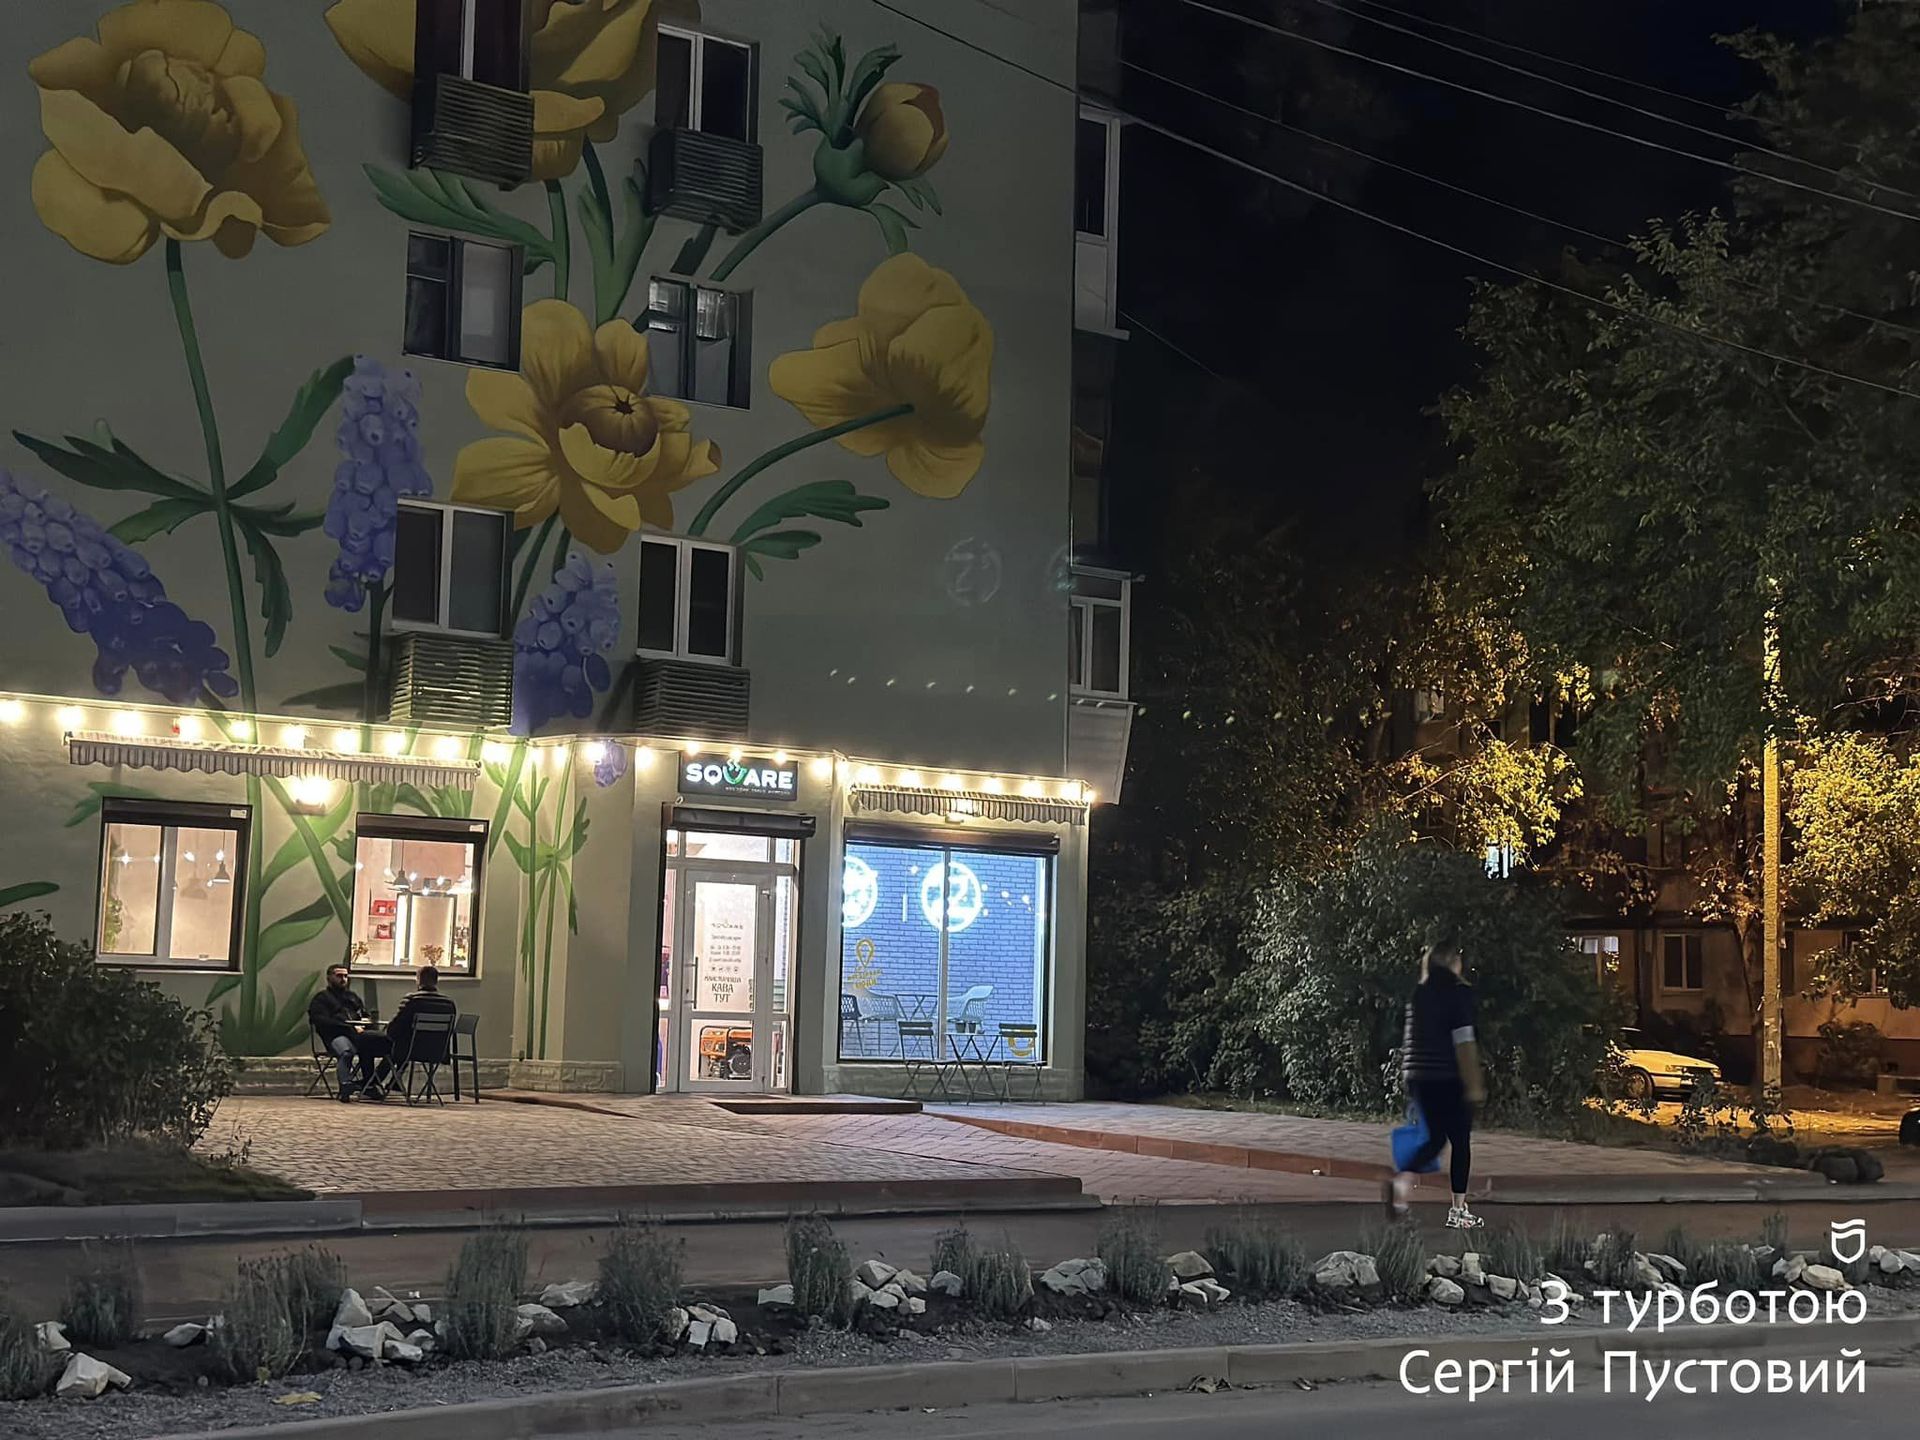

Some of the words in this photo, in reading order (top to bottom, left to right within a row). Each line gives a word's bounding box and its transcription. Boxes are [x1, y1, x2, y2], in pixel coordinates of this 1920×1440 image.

[685, 762, 793, 790] SQUARE
[711, 983, 734, 994] КАВА
[713, 993, 731, 1003] ТУТ
